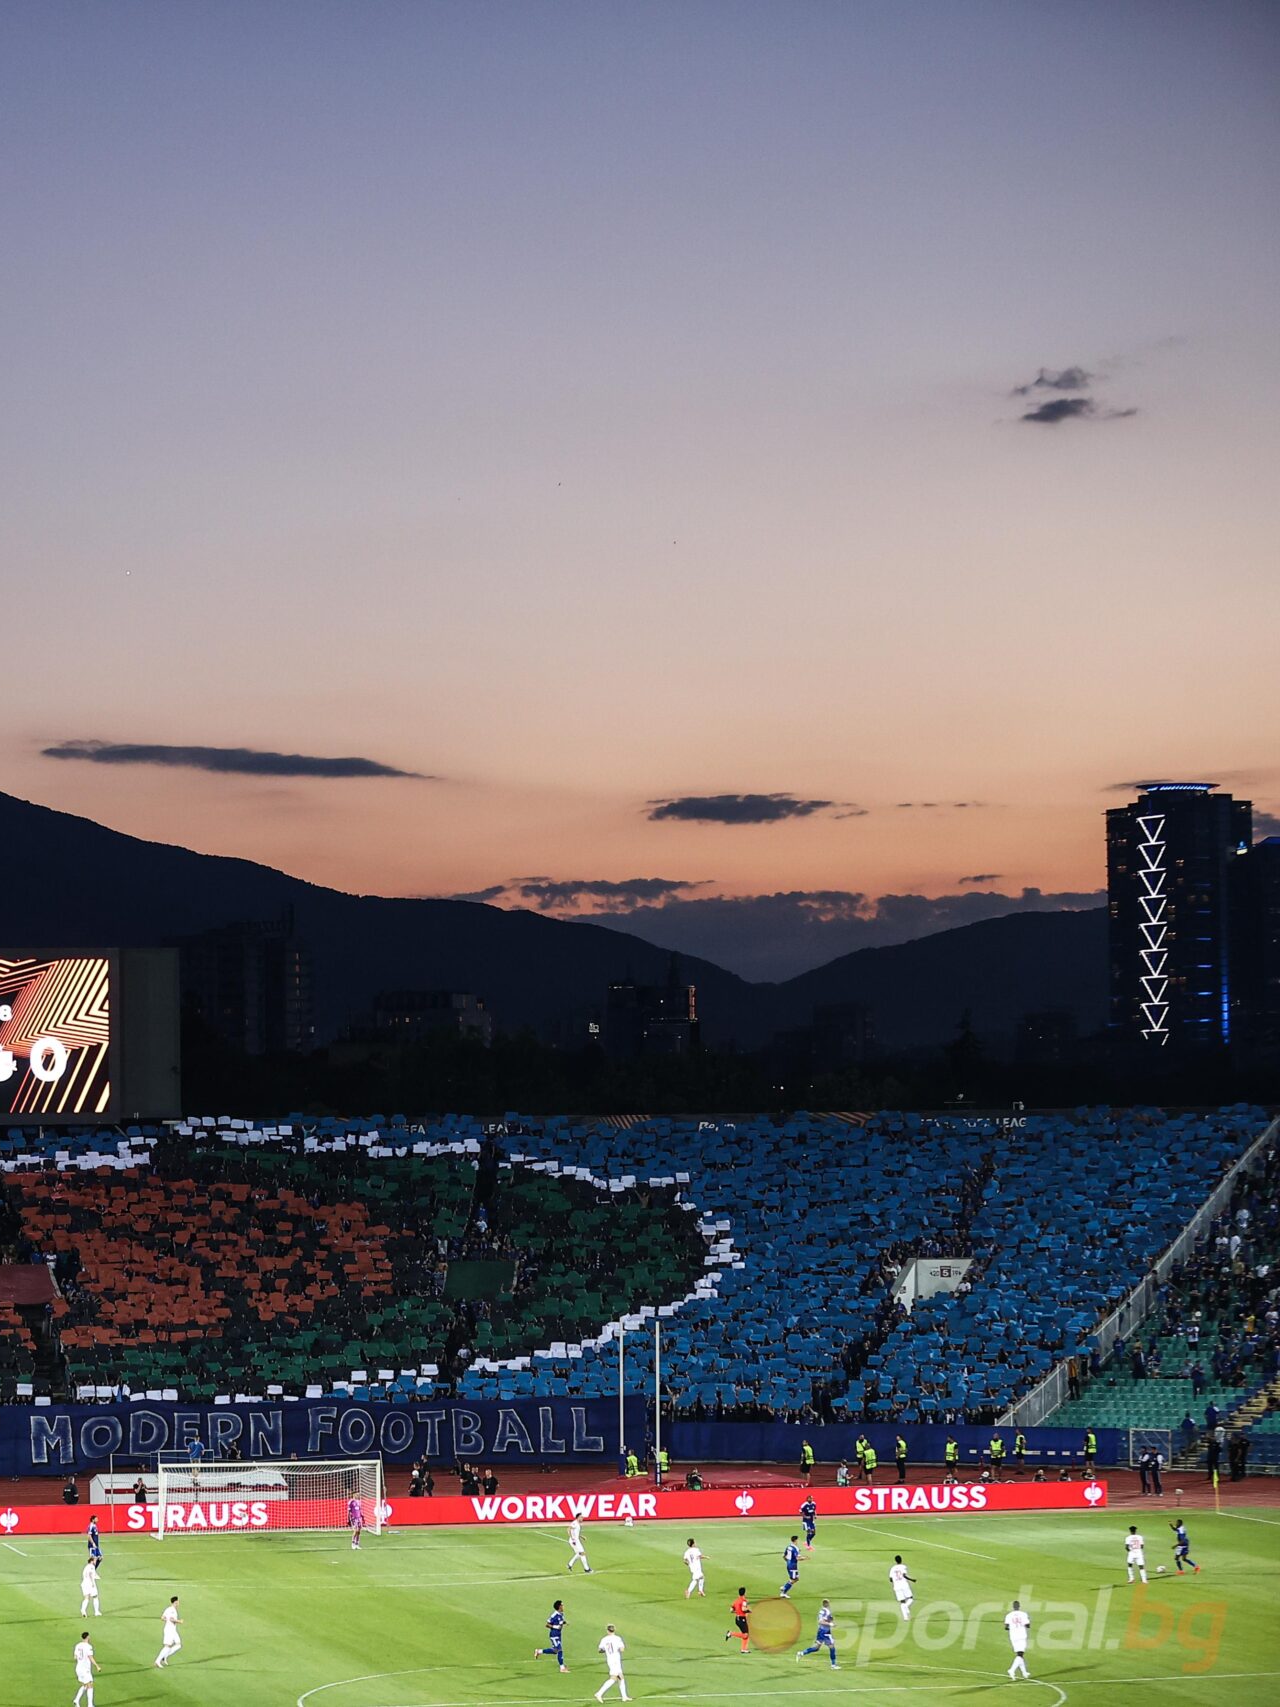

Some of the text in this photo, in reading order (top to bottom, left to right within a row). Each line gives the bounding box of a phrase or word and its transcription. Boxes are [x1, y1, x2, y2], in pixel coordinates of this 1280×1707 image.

[29, 1036, 68, 1082] 0
[30, 1410, 283, 1464] MODERN
[307, 1405, 604, 1456] FOOTBALL
[472, 1493, 657, 1521] WORKWEAR
[855, 1485, 987, 1511] STRAUSS
[127, 1502, 268, 1529] STRAUSS
